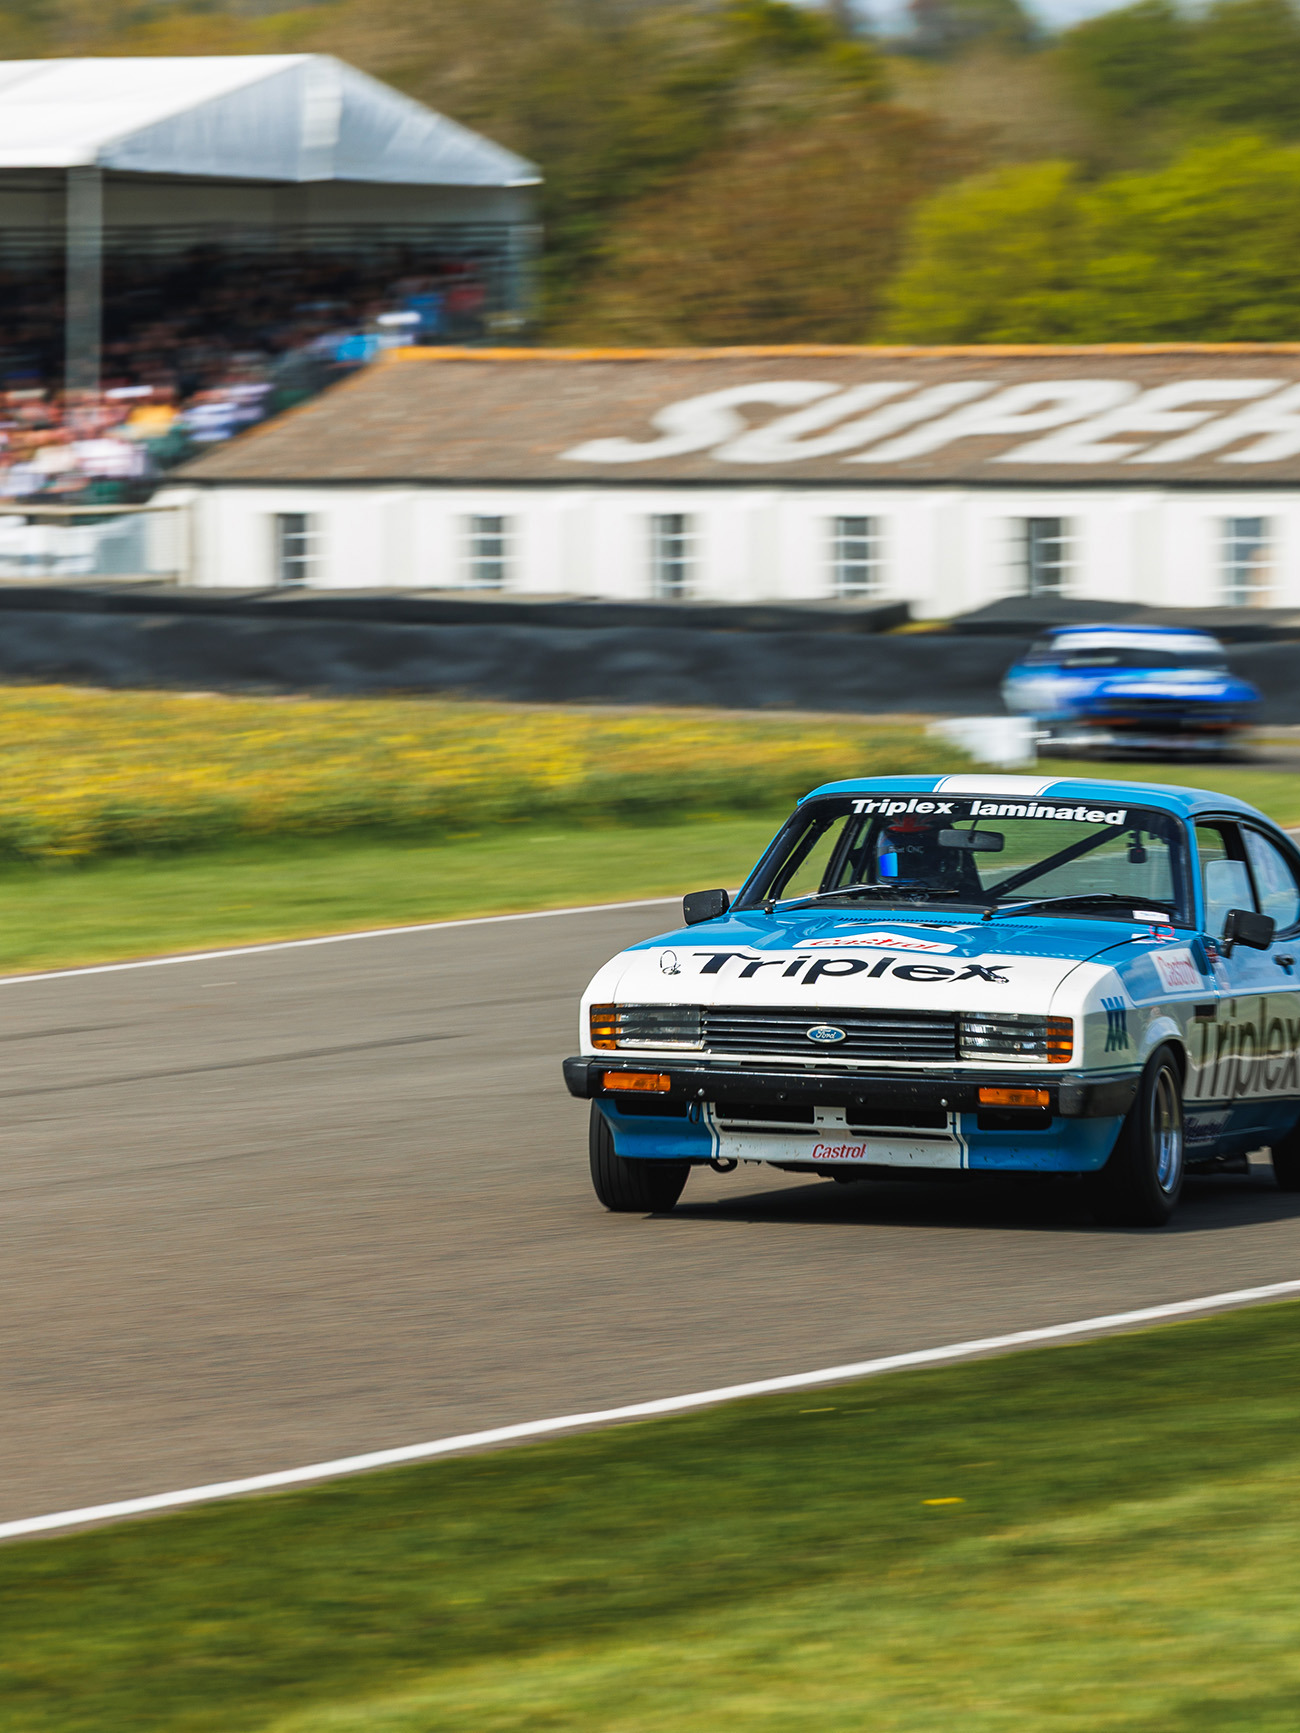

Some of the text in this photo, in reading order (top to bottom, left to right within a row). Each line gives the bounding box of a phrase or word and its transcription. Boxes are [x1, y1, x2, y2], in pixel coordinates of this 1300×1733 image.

[851, 798, 1127, 825] Triplex laminated
[809, 938, 942, 950] Castrol
[692, 952, 1014, 985] Triplex
[812, 1143, 867, 1159] Castrol
